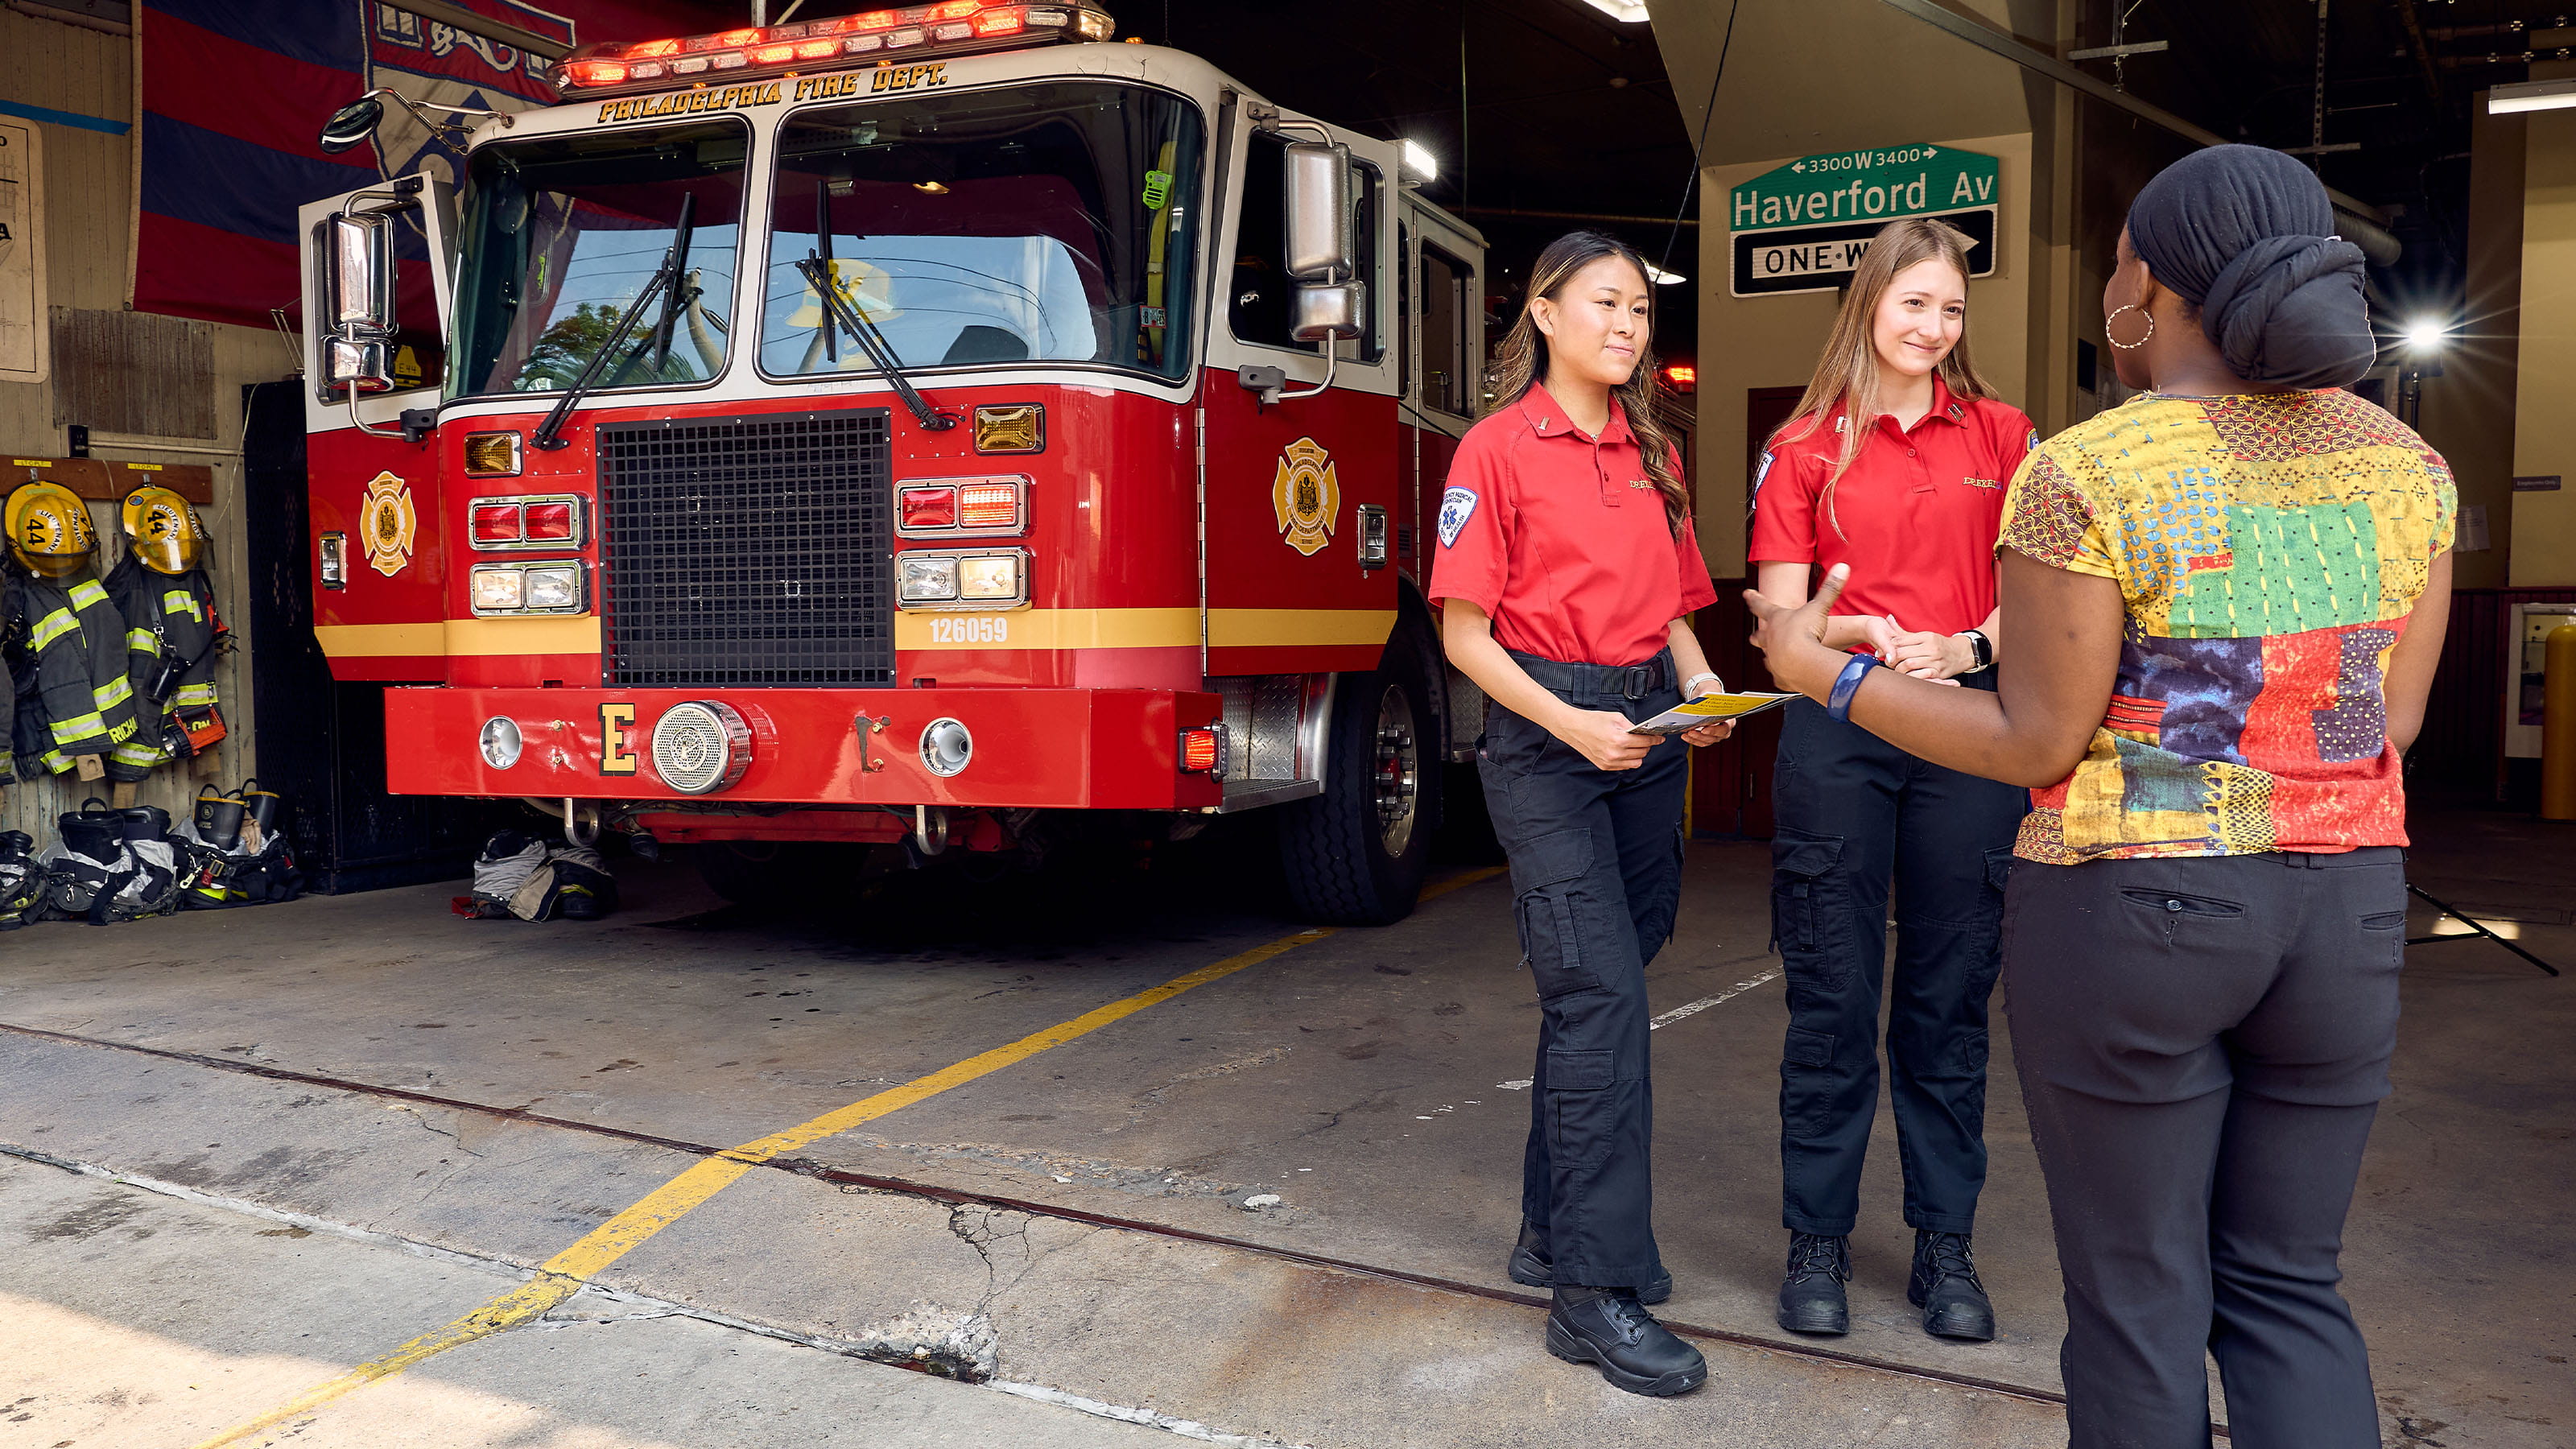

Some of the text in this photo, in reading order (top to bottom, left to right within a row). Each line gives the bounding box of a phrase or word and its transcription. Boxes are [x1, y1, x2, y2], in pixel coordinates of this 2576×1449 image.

[597, 63, 948, 123] PHILADELPHIA FIRE DEPT.
[1809, 148, 1920, 173] 3300 W 3400
[1735, 171, 1993, 226] Haverford Av
[1765, 245, 1832, 274] ONE
[1293, 459, 1321, 474] PHILADELPHIA
[1963, 477, 1996, 488] DREXEL
[27, 519, 45, 546] 44
[40, 510, 62, 553] LIEUTENANT
[147, 511, 169, 535] 44
[1290, 514, 1325, 534] FIRE DEPARTMENT
[929, 617, 1007, 642] 126059
[598, 703, 636, 776] E
